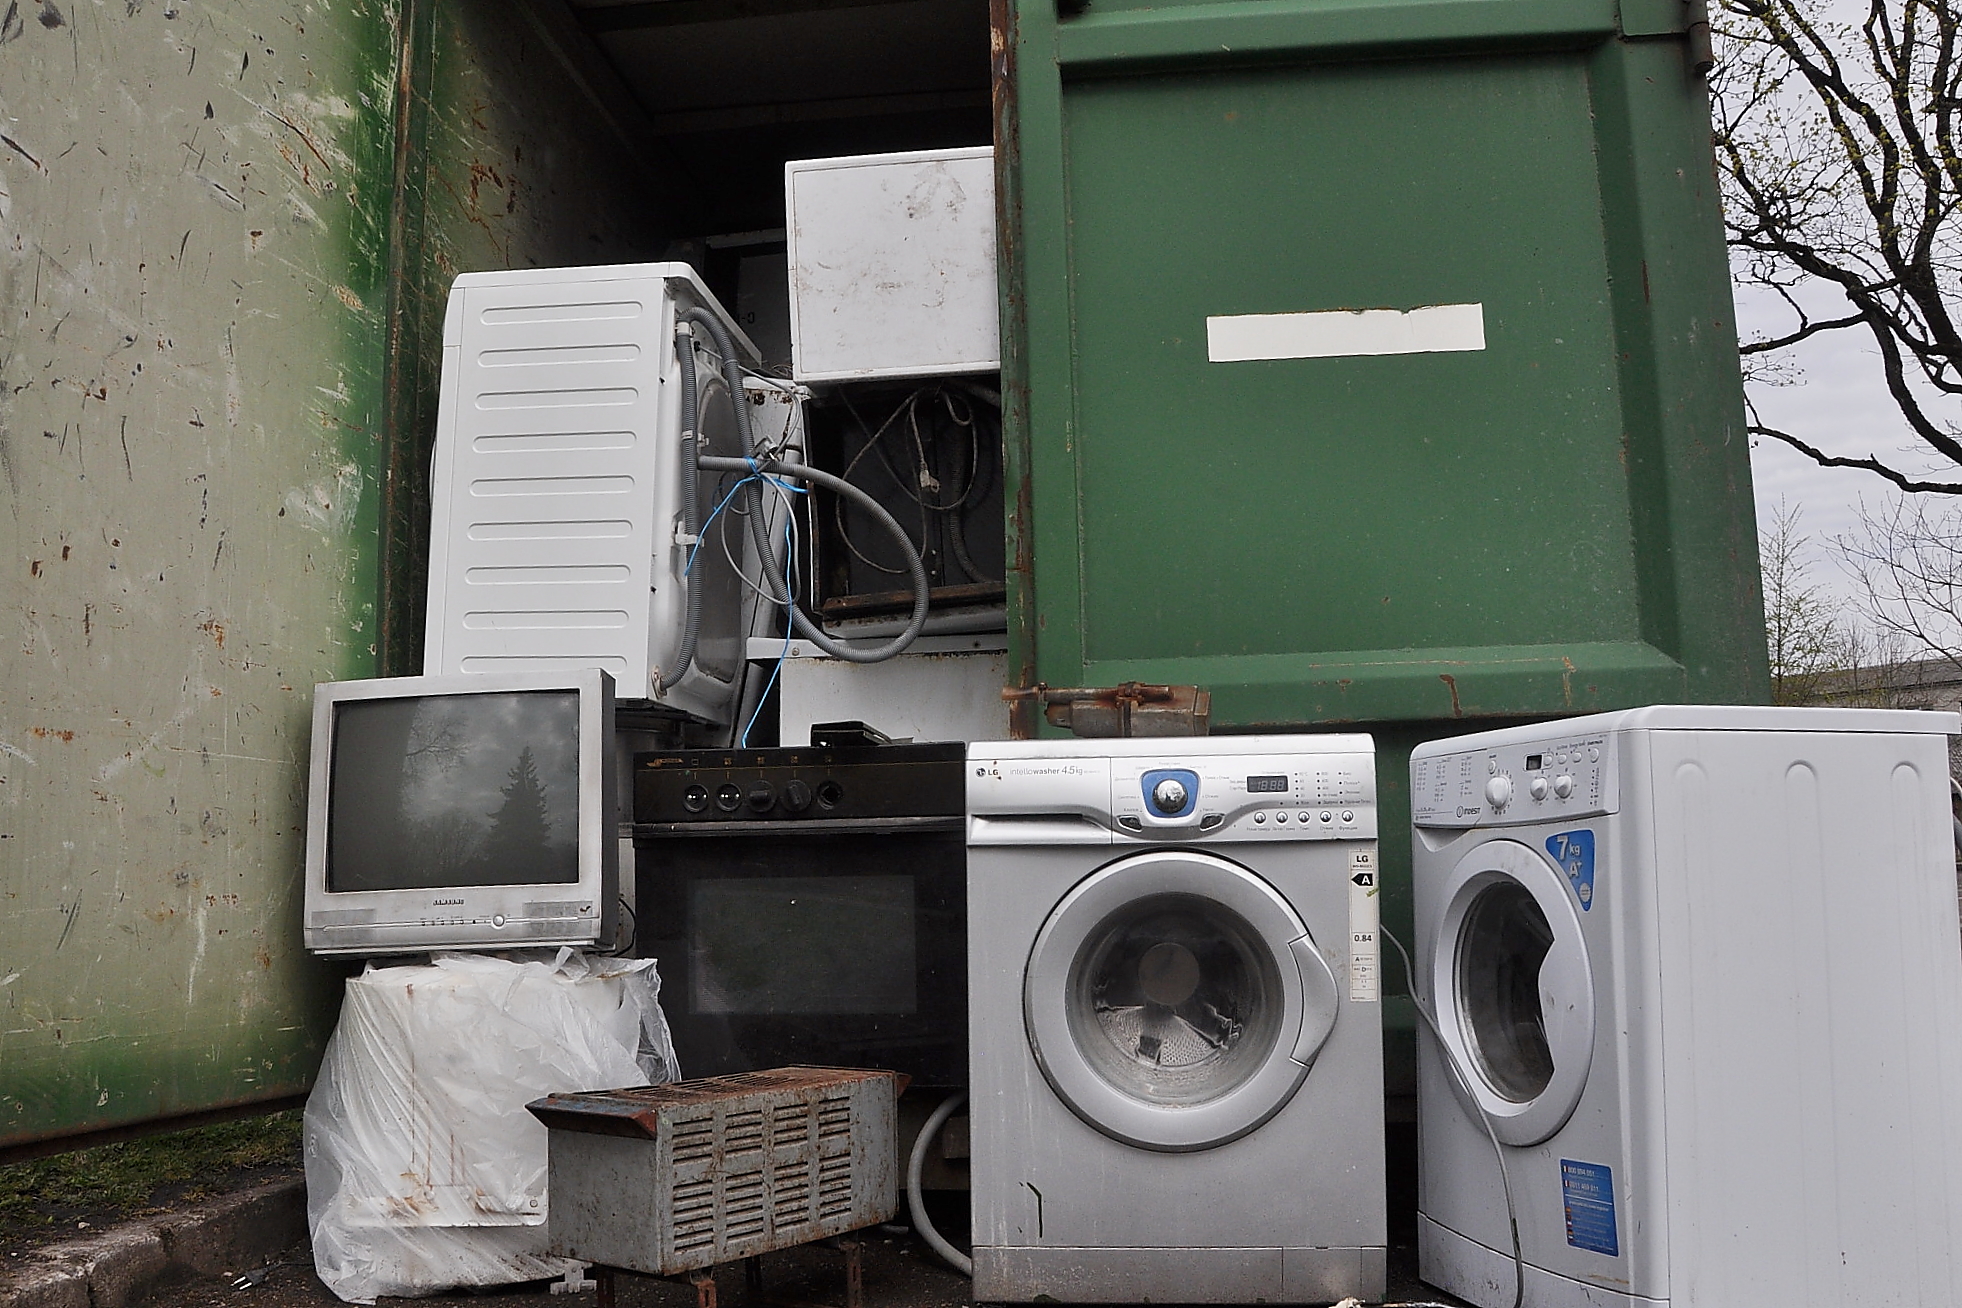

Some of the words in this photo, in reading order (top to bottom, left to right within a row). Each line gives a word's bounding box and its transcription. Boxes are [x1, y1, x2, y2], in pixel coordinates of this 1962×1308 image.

[1010, 767, 1060, 775] intellowasher
[1556, 835, 1569, 860] 7
[1569, 843, 1581, 857] kg
[1356, 855, 1369, 863] LG
[1361, 875, 1371, 885] A
[1354, 934, 1372, 942] 0.84
